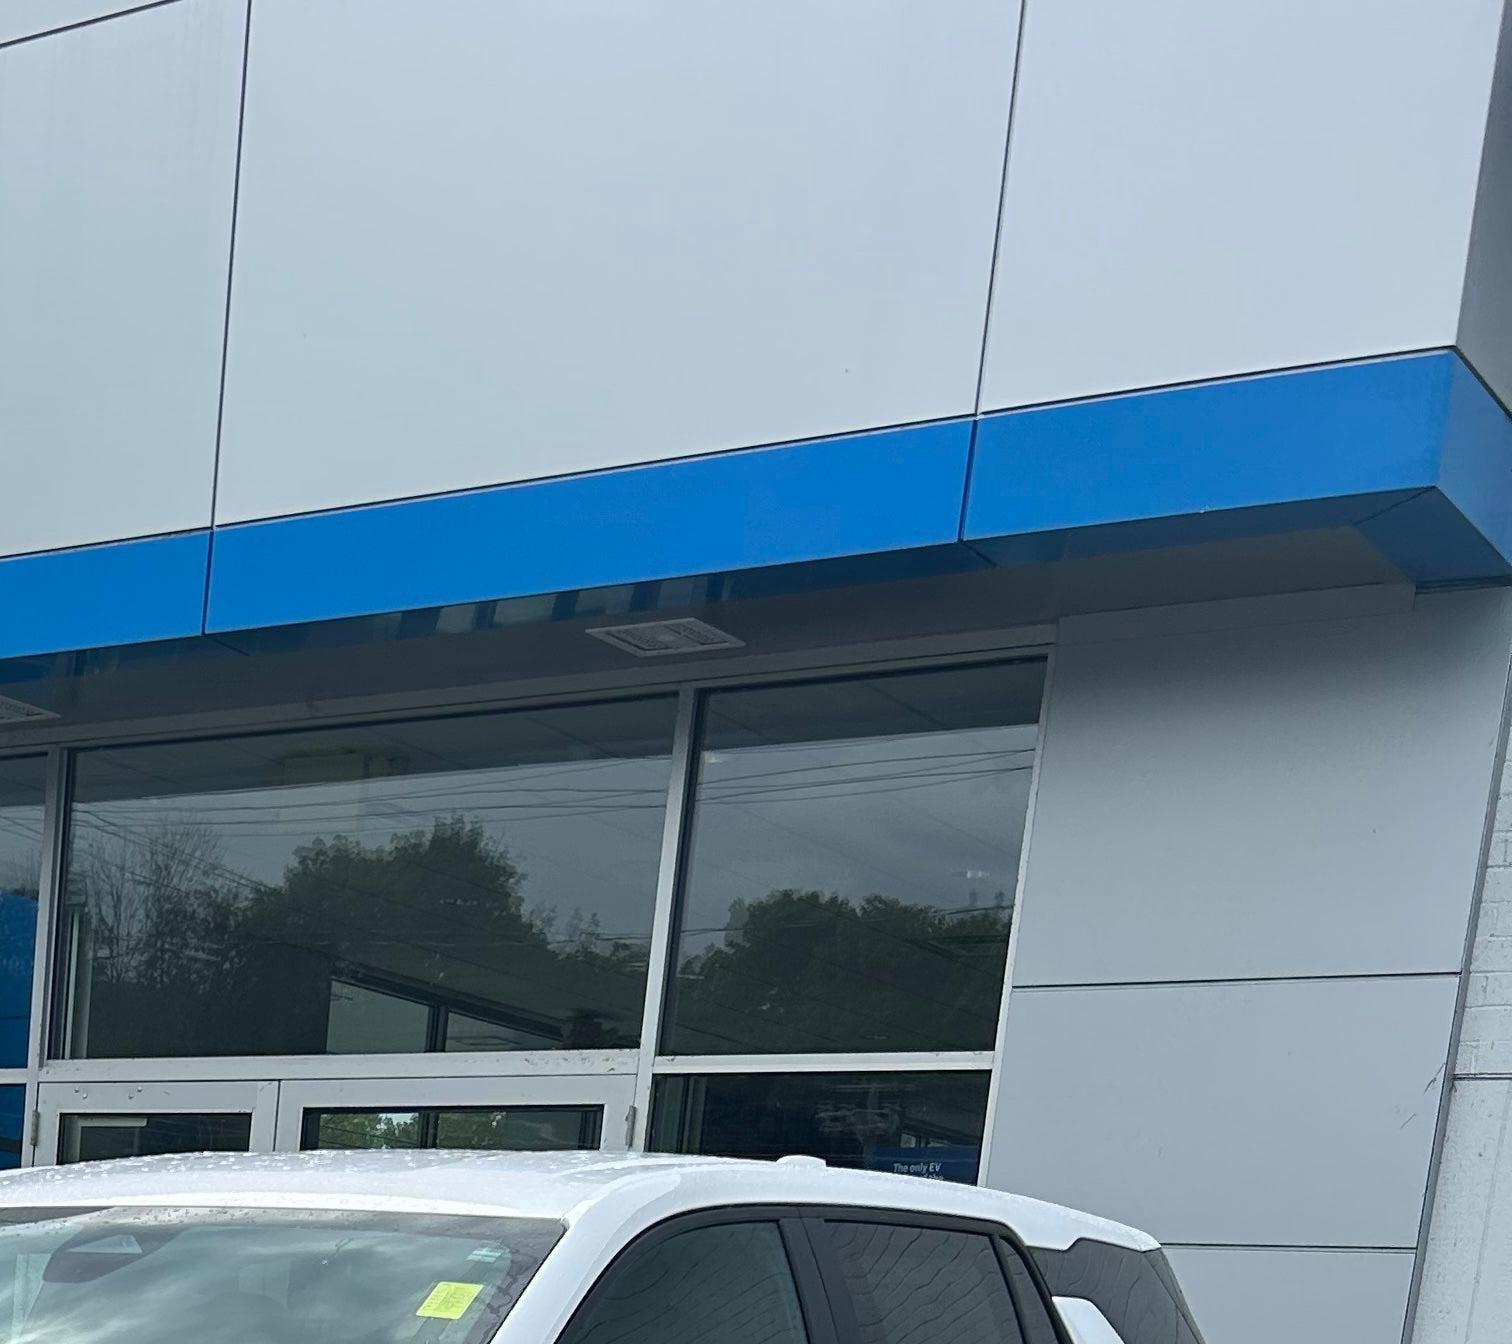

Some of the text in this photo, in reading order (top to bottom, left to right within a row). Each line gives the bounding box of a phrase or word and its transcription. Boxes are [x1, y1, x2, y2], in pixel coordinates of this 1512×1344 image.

[893, 1162, 942, 1174] The only EV
